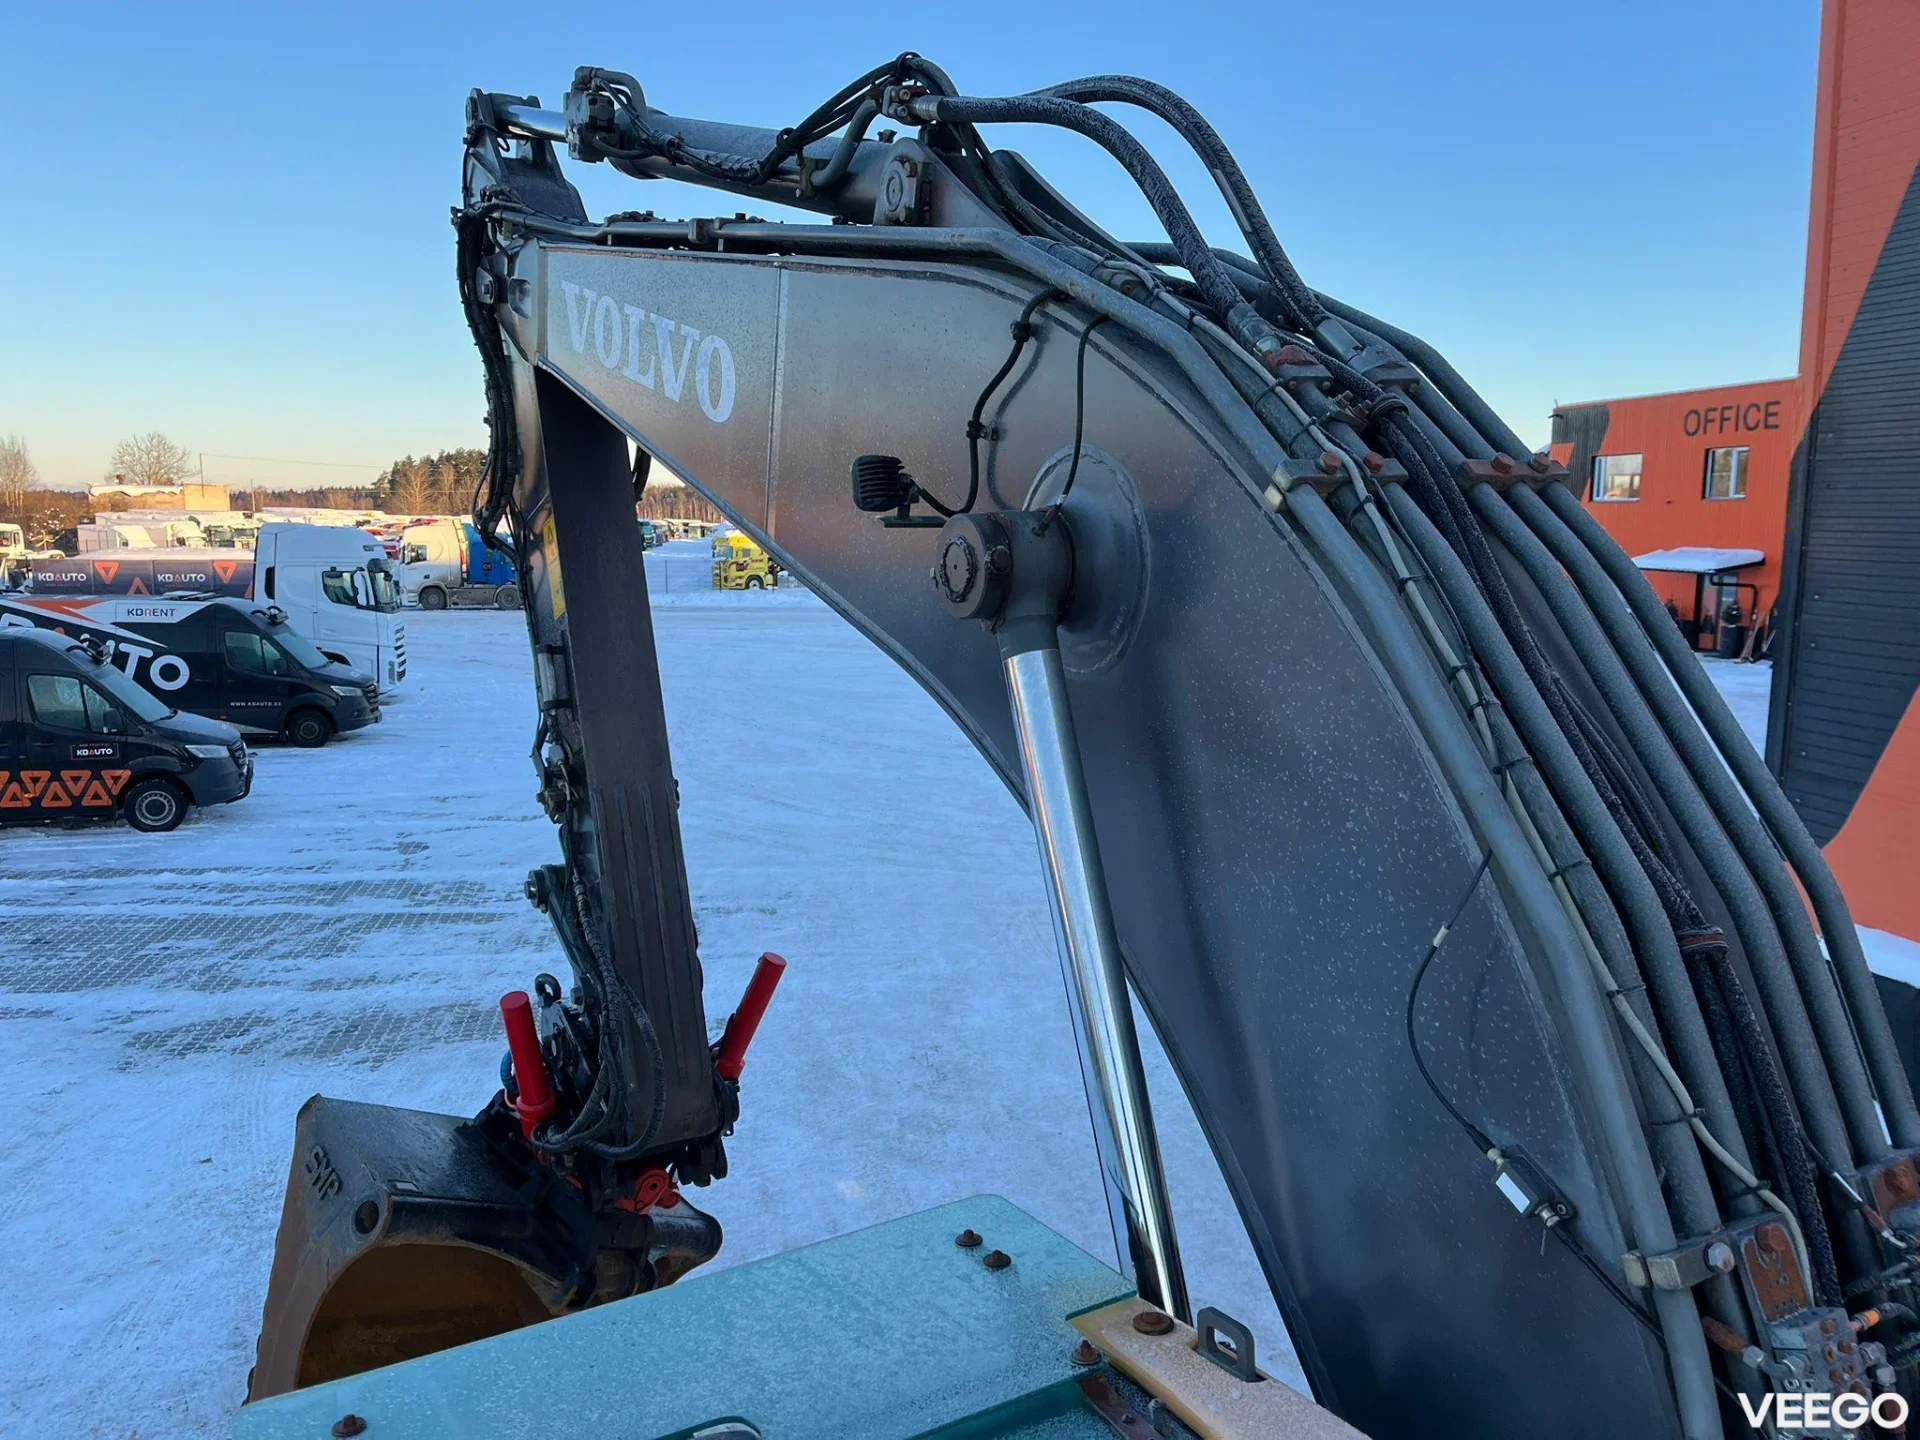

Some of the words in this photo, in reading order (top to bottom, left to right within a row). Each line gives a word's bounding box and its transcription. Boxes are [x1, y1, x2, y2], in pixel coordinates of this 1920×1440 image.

[561, 279, 736, 423] VOLVO
[1684, 400, 1781, 437] OFFICE
[127, 608, 176, 617] KBRENT
